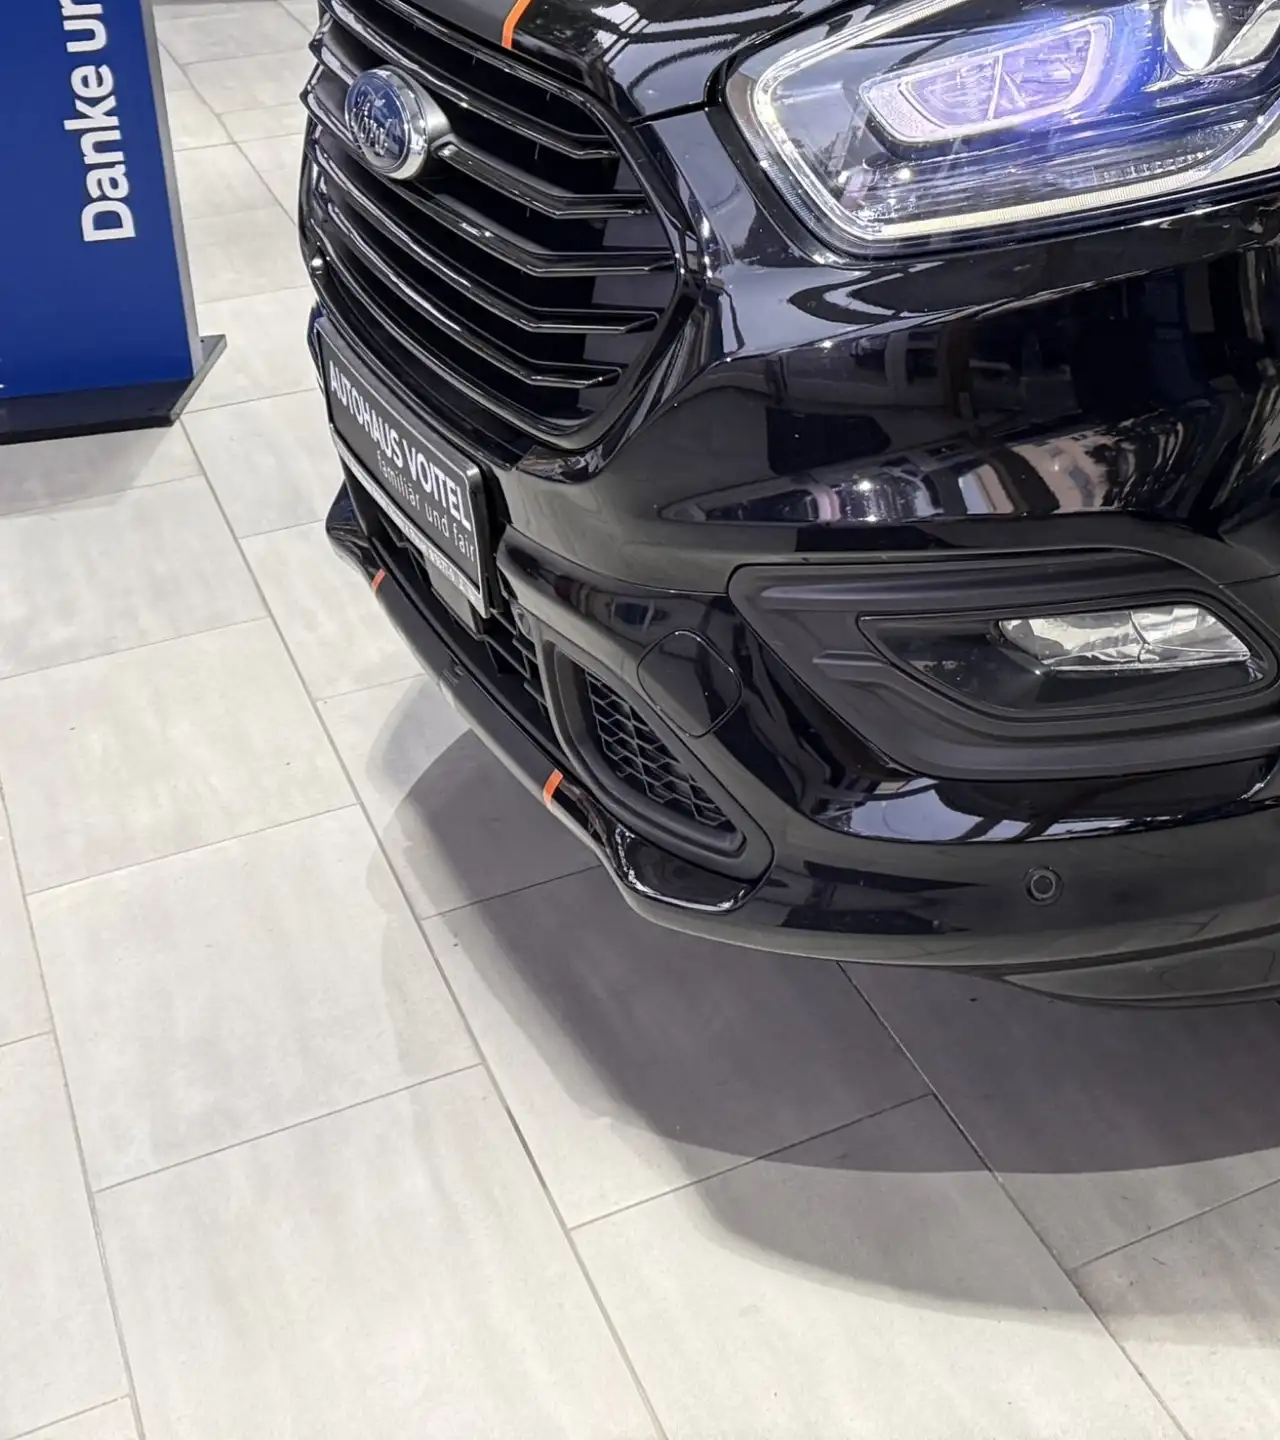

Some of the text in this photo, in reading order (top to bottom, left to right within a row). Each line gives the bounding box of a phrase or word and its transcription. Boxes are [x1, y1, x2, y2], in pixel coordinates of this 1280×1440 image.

[62, 63, 137, 243] Danke
[329, 359, 403, 469] AUTOHAUS
[401, 436, 472, 533] VOITEL
[376, 449, 420, 512] familiär
[424, 501, 450, 538] und
[452, 522, 475, 563] fair
